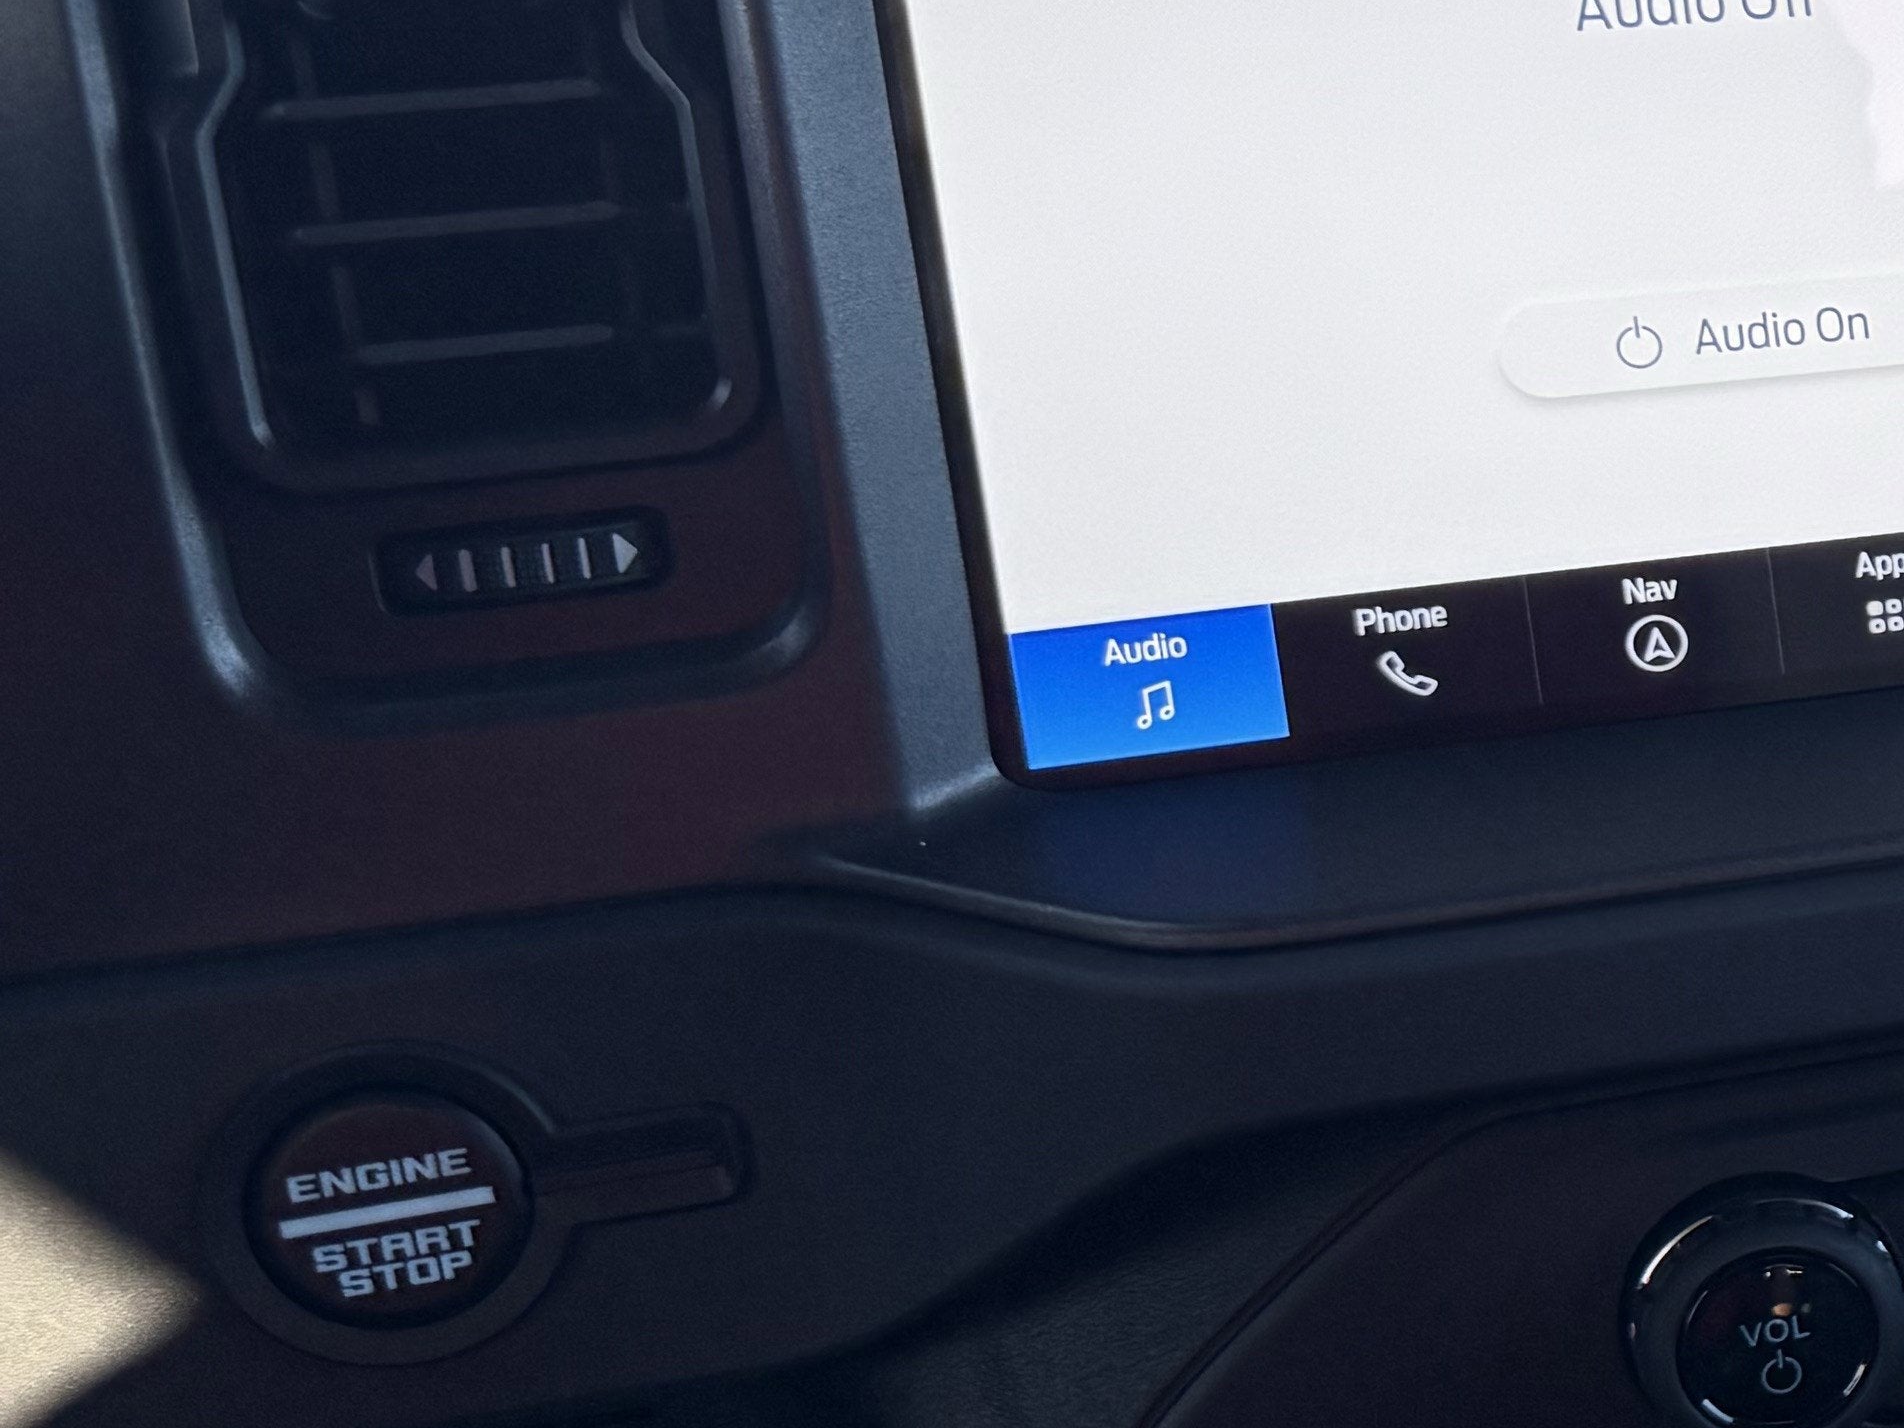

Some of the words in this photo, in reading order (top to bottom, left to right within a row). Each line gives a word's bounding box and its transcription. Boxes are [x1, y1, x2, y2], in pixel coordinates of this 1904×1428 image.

[1695, 311, 1806, 357] Audio
[1815, 306, 1871, 343] On
[1620, 573, 1679, 606] Nav
[1351, 598, 1449, 638] Phone
[1101, 629, 1188, 667] Audio
[286, 1146, 473, 1204] ENGINE
[311, 1218, 482, 1273] START
[340, 1249, 473, 1298] STOP
[1738, 1314, 1812, 1350] VOL
